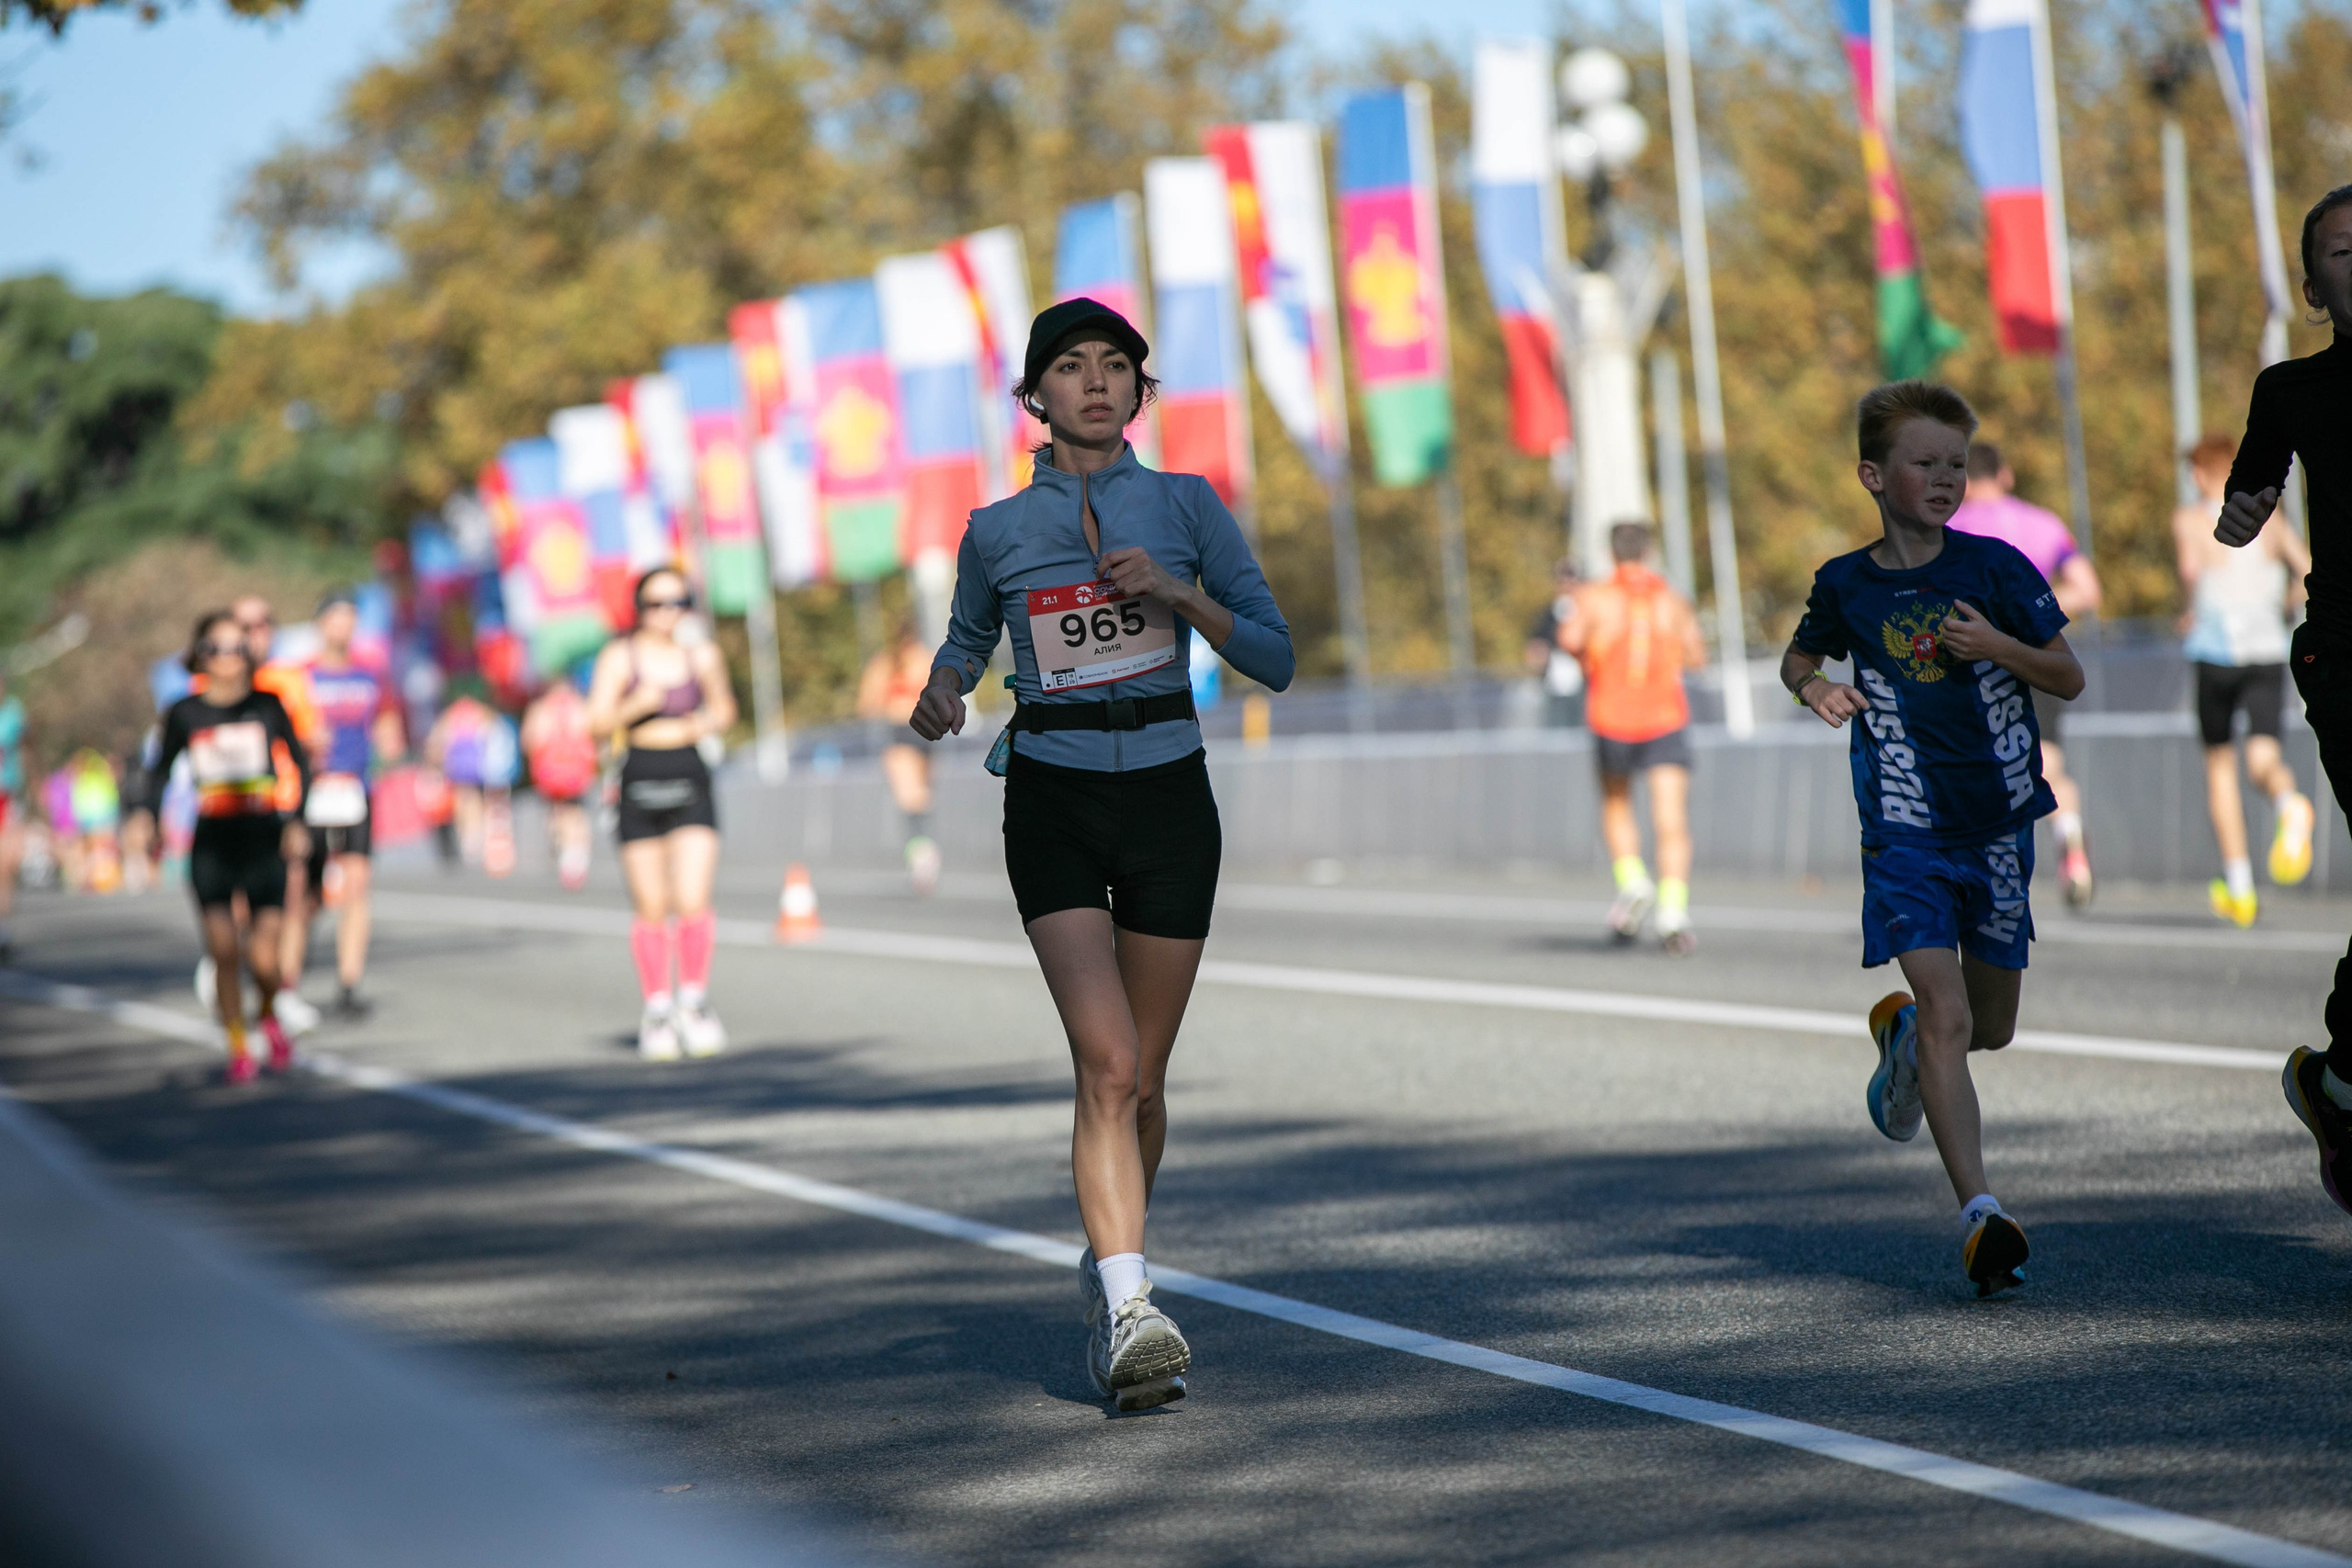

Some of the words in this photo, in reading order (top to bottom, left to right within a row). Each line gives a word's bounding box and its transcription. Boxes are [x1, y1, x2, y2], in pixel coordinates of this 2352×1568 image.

[1042, 595, 1057, 605] 21.1
[1059, 601, 1146, 648] 965
[1093, 643, 1122, 656] АЛИЯ
[1860, 668, 1933, 829] RUSSIA
